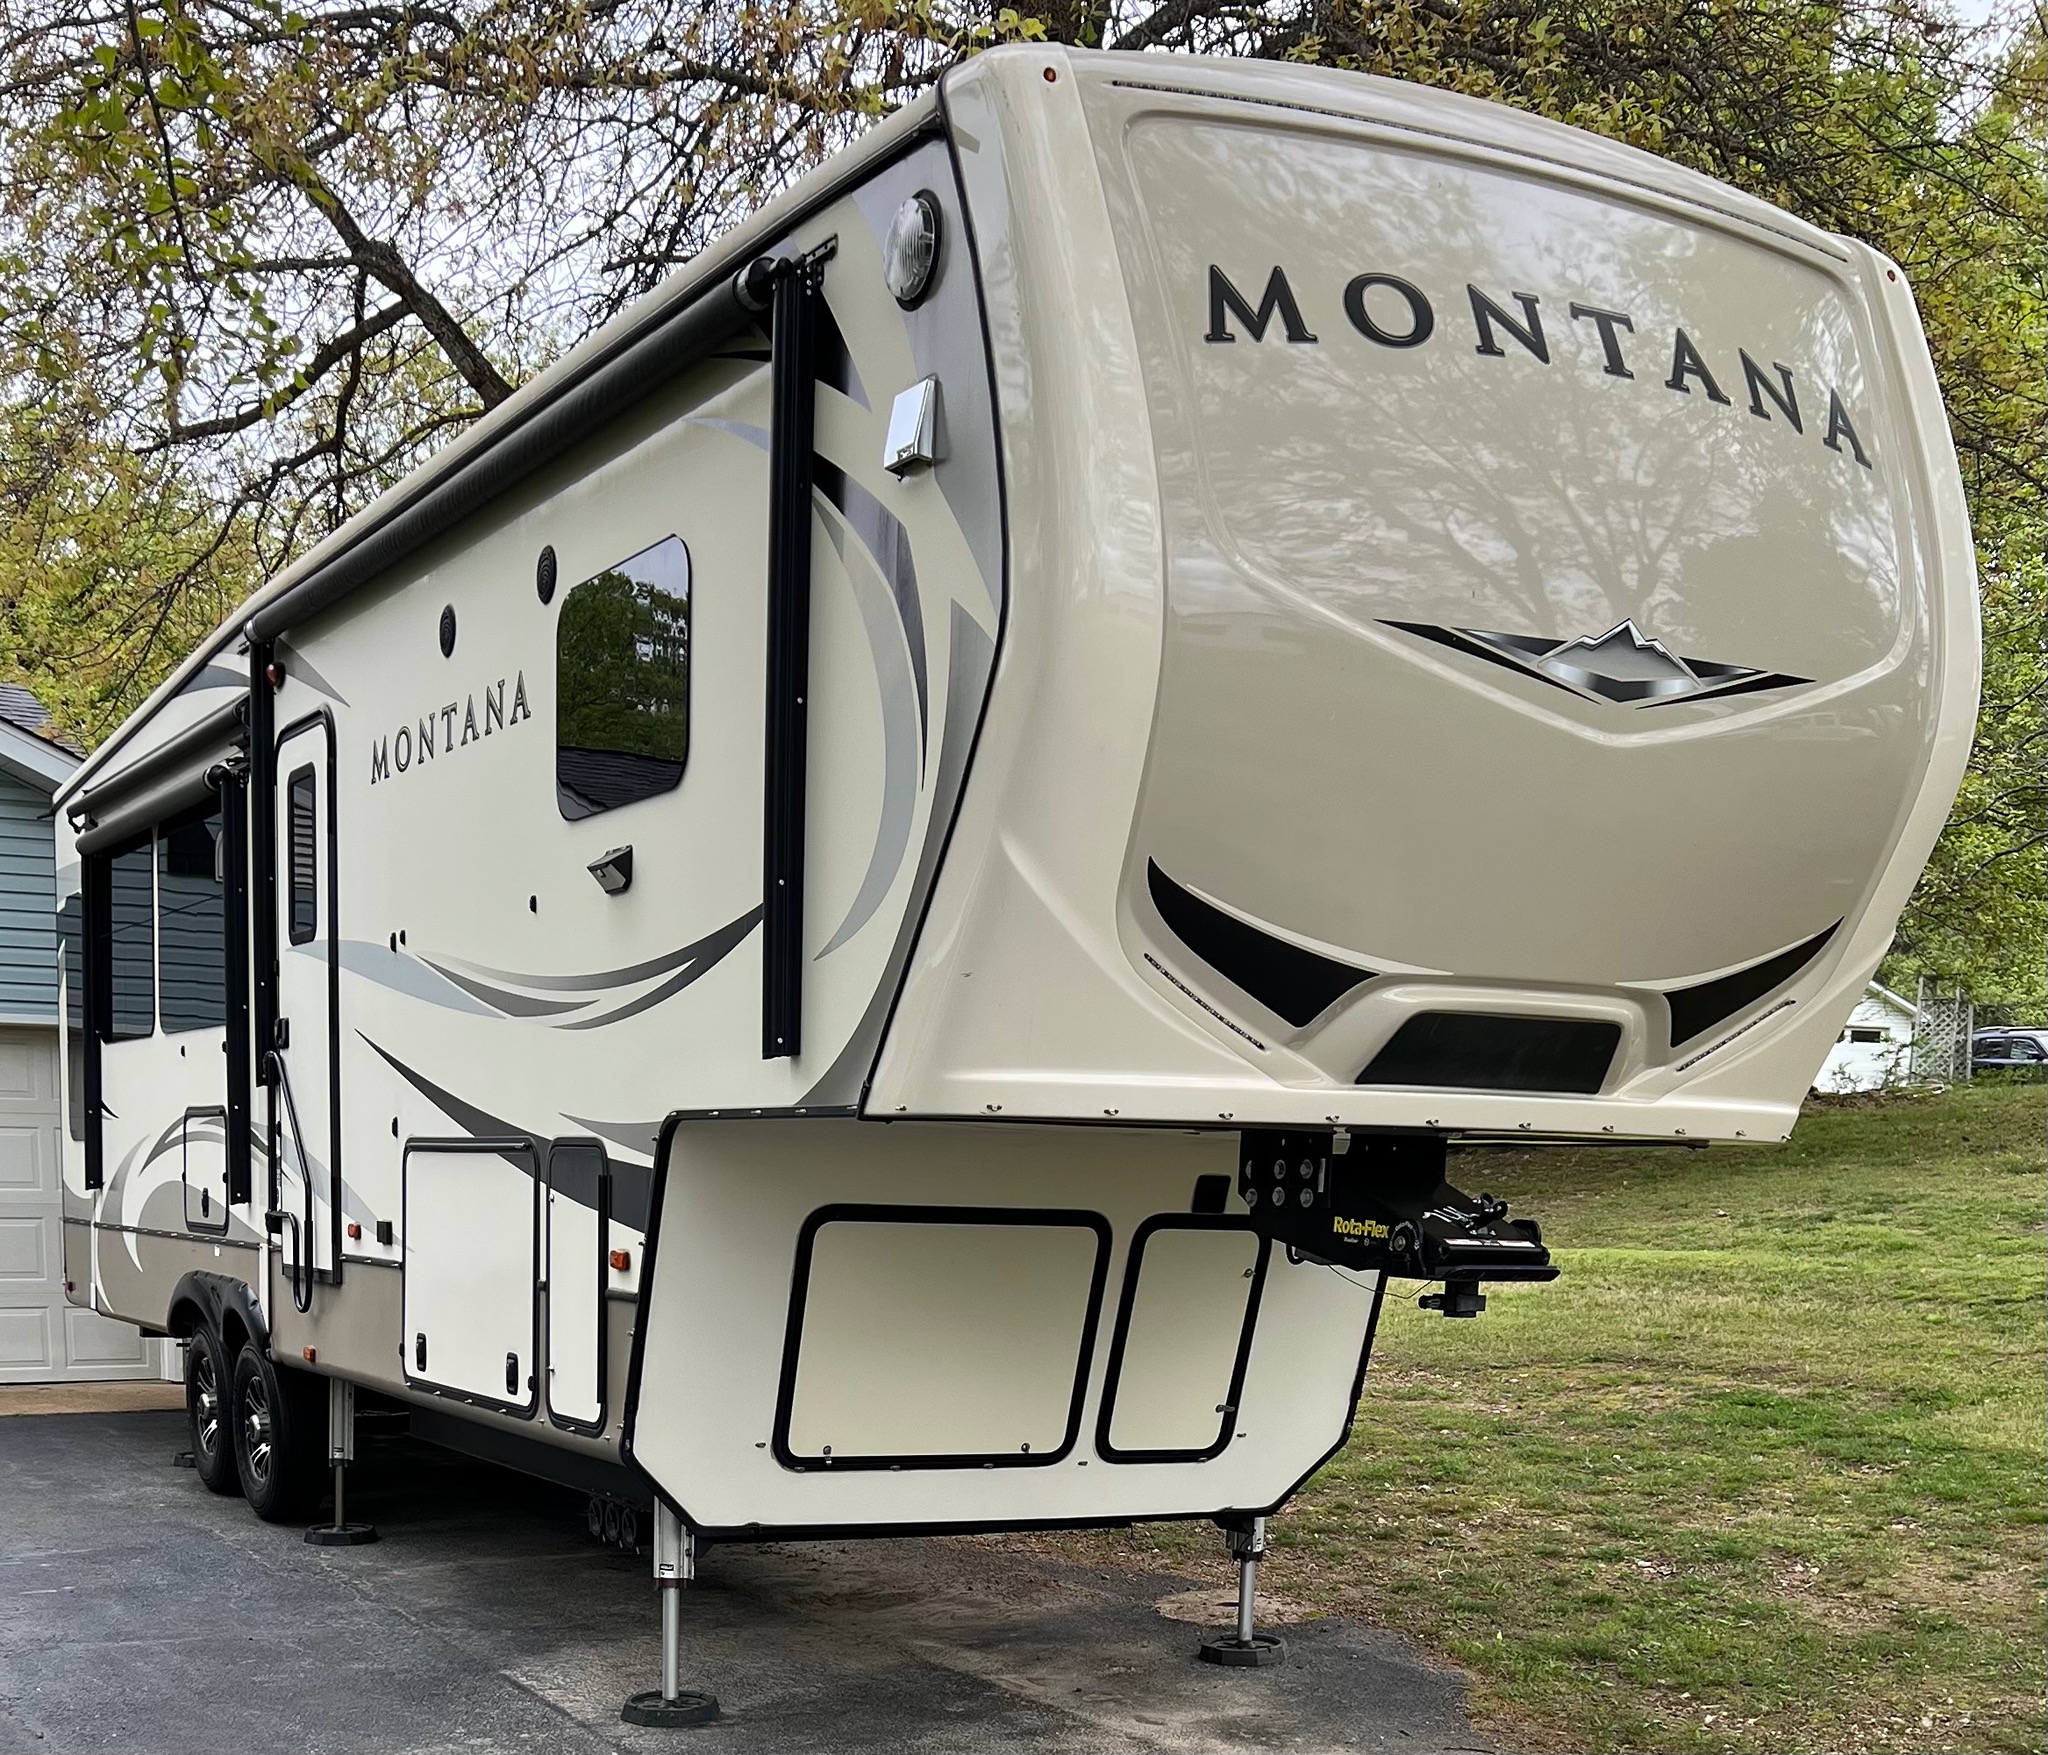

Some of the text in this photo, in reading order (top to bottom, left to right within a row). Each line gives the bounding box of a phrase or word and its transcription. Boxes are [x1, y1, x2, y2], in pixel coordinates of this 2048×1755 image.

[1204, 264, 1873, 470] MONTANA
[371, 669, 532, 785] MONTANA
[1333, 1216, 1390, 1238] Rota-Flex
